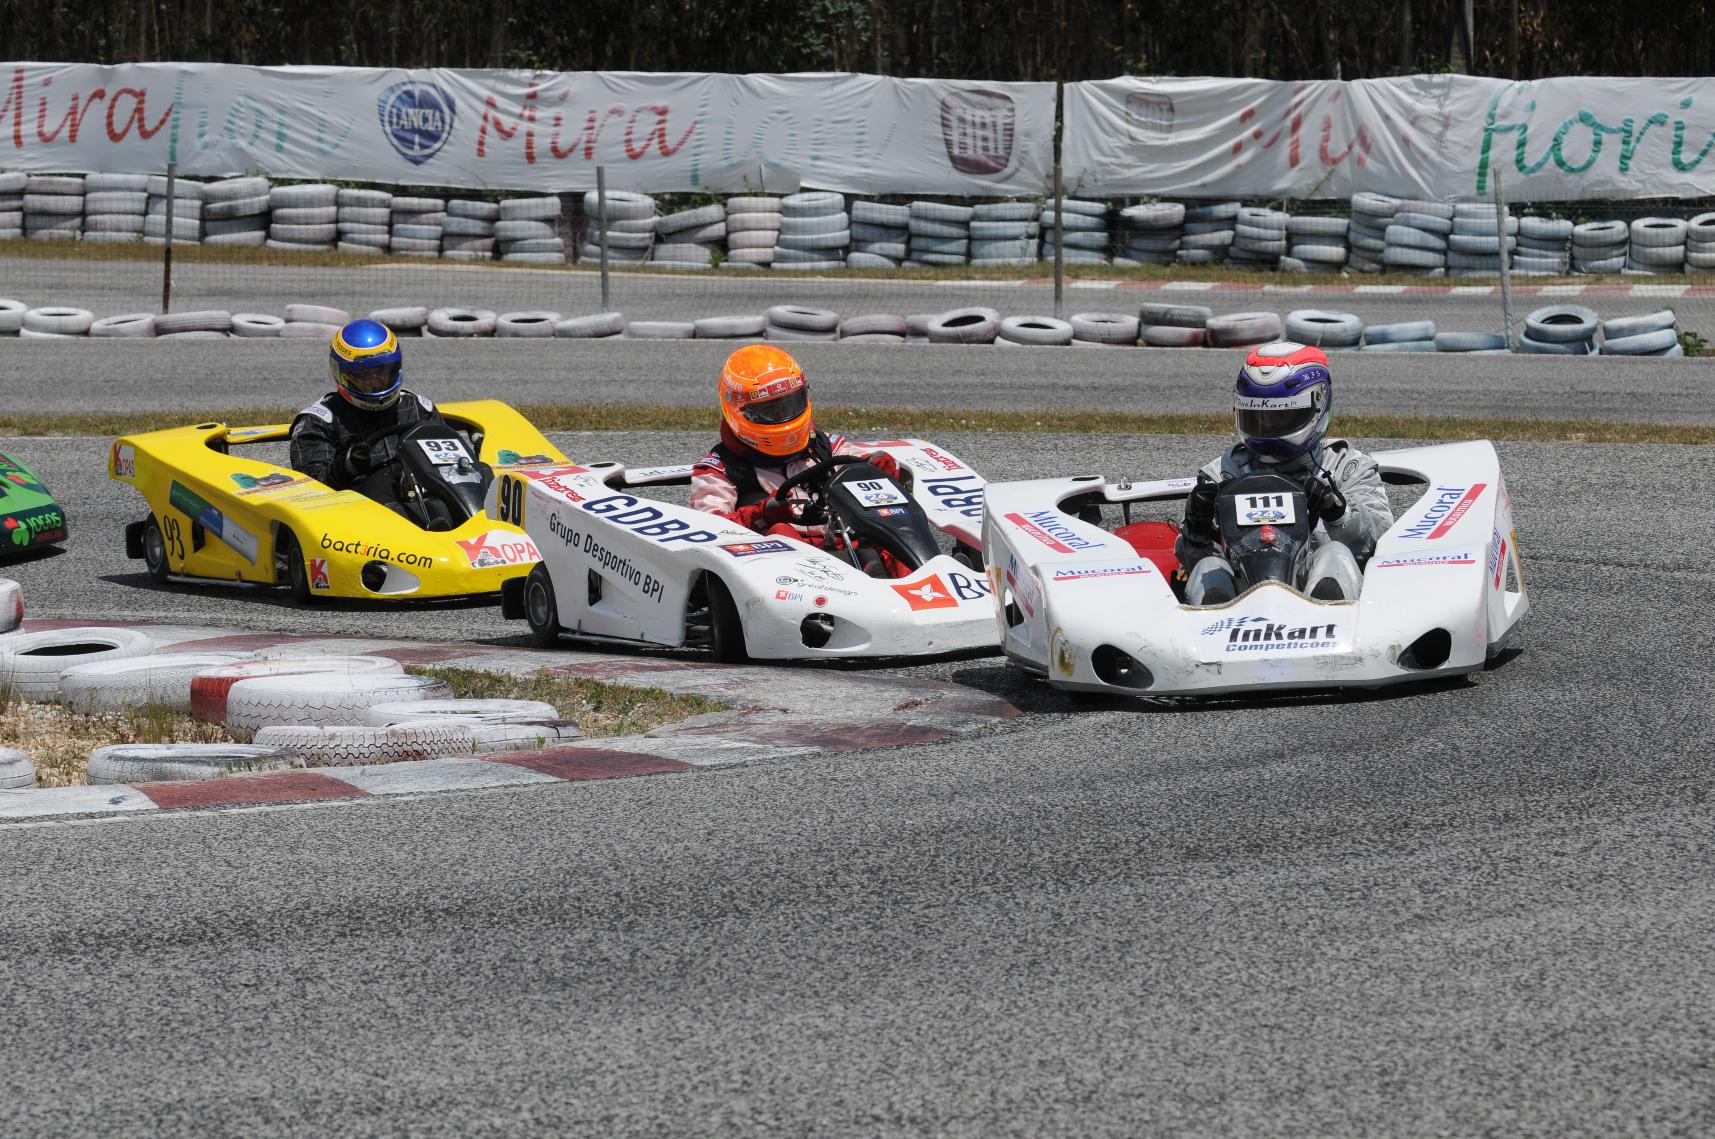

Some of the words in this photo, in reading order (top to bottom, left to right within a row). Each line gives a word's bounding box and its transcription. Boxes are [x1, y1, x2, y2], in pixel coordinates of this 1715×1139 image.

[391, 107, 442, 131] LANCIA
[425, 440, 459, 451] 93
[500, 474, 523, 527] 90
[857, 481, 883, 492] 90
[1245, 495, 1284, 508] 111
[582, 495, 718, 543] GDBP
[1398, 487, 1466, 539] Mucoral
[163, 515, 185, 561] 93
[1023, 510, 1106, 550] Mucoral
[549, 512, 581, 548] Grupo
[583, 533, 642, 586] Desportivo
[642, 574, 665, 604] BPI
[788, 592, 803, 602] BPI
[1229, 623, 1338, 643] InKart
